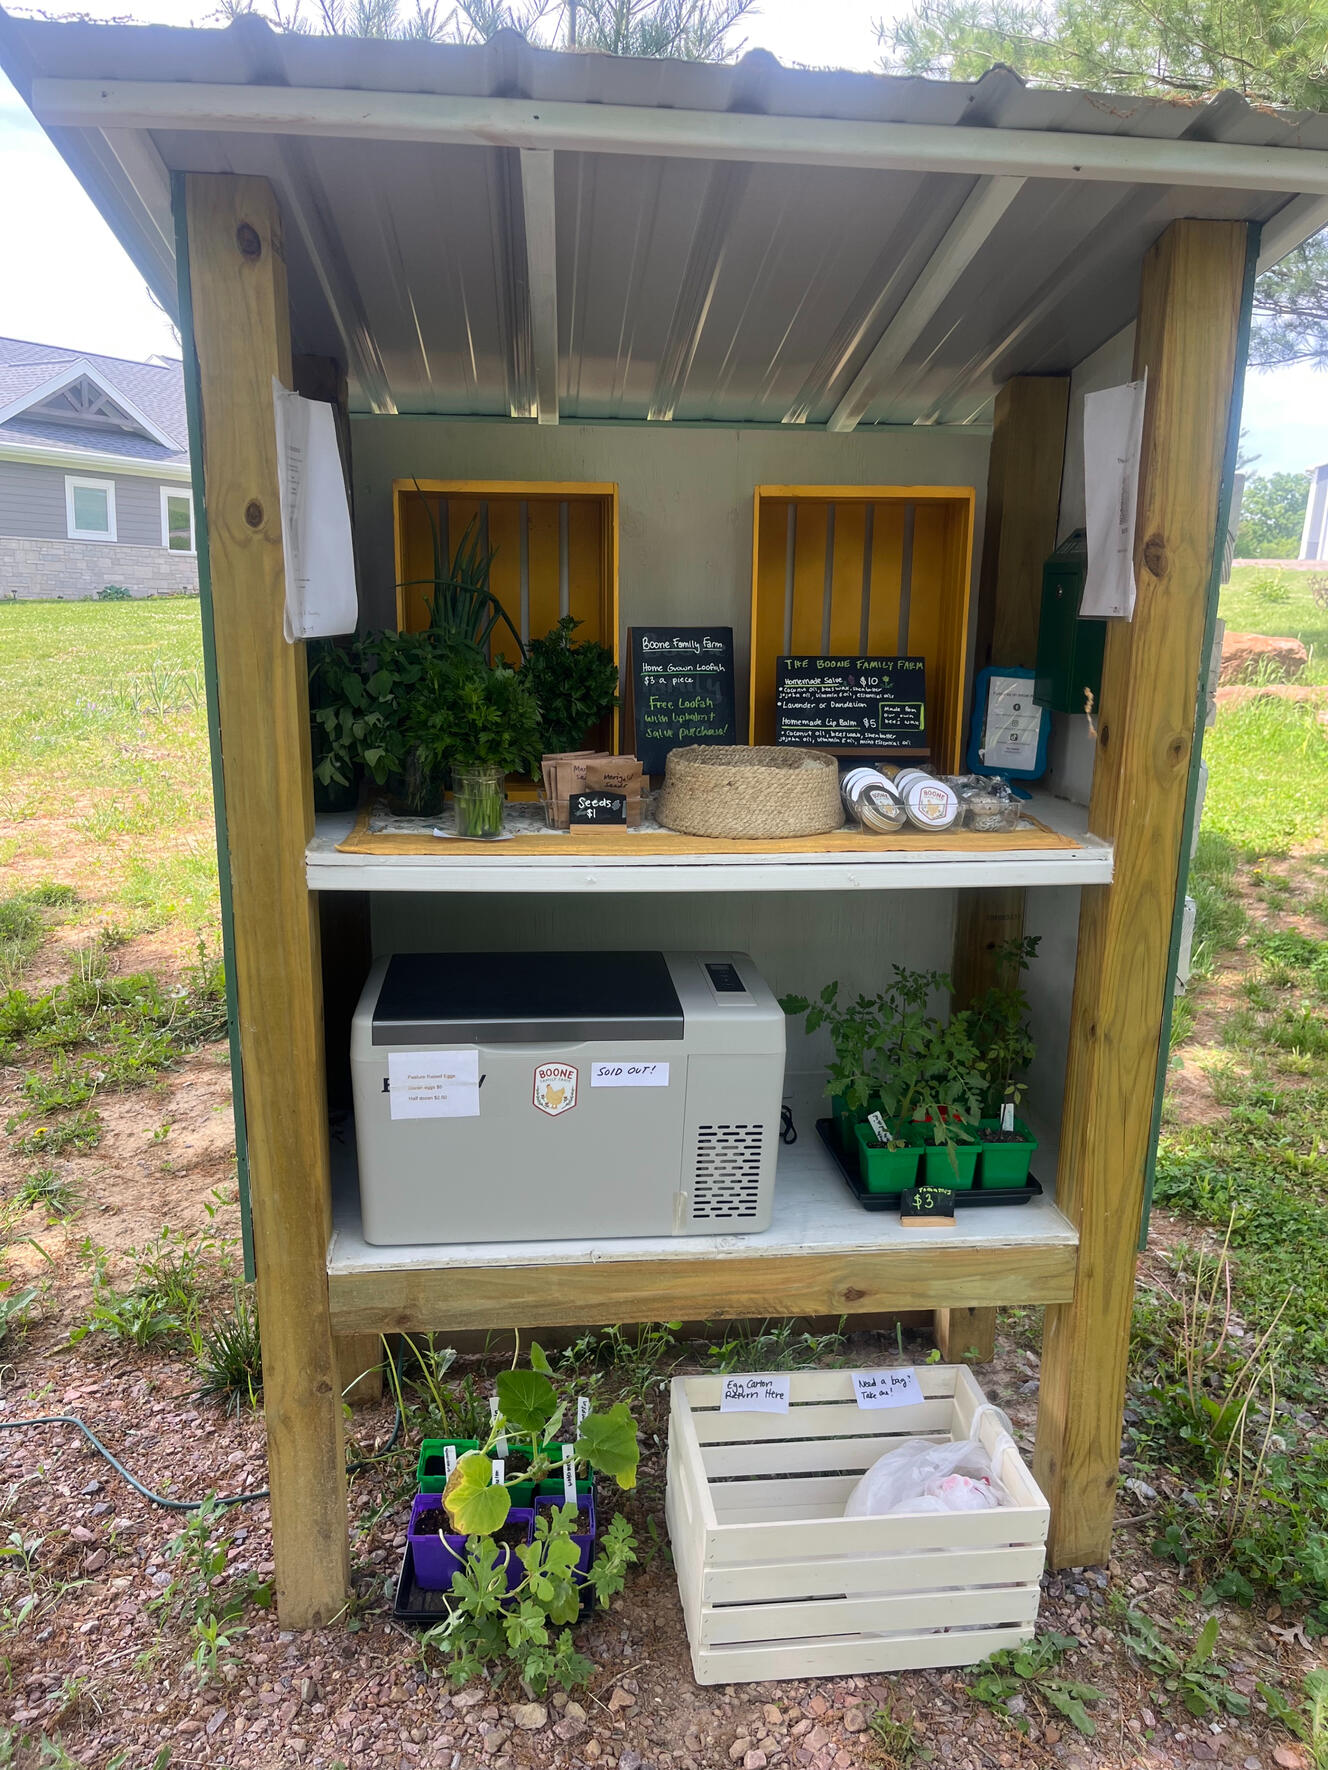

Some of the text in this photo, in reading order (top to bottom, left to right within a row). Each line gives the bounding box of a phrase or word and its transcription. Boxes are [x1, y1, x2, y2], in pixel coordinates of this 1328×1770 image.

[642, 637, 722, 653] Boone Family Farm
[642, 662, 663, 672] Home
[696, 663, 726, 672] Loofah
[784, 660, 924, 670] THE BOONE FAMILY FARM
[672, 676, 694, 686] piece
[860, 676, 878, 687] $10
[649, 696, 713, 710] Free Loofah
[645, 714, 669, 723] with
[782, 717, 822, 726] Homemade
[825, 718, 837, 728] Lip
[862, 718, 877, 729] $5
[924, 789, 946, 801] BOONE
[578, 797, 612, 809] Seeds
[586, 809, 597, 819] $1
[538, 1068, 575, 1080] BOONE
[627, 1065, 657, 1076] OUT!
[912, 1193, 934, 1210] $3
[727, 1379, 772, 1394] Egg Carton
[859, 1377, 877, 1388] Need
[891, 1374, 911, 1388] bag?
[725, 1389, 784, 1400] Return Here
[861, 1391, 877, 1400] Take
